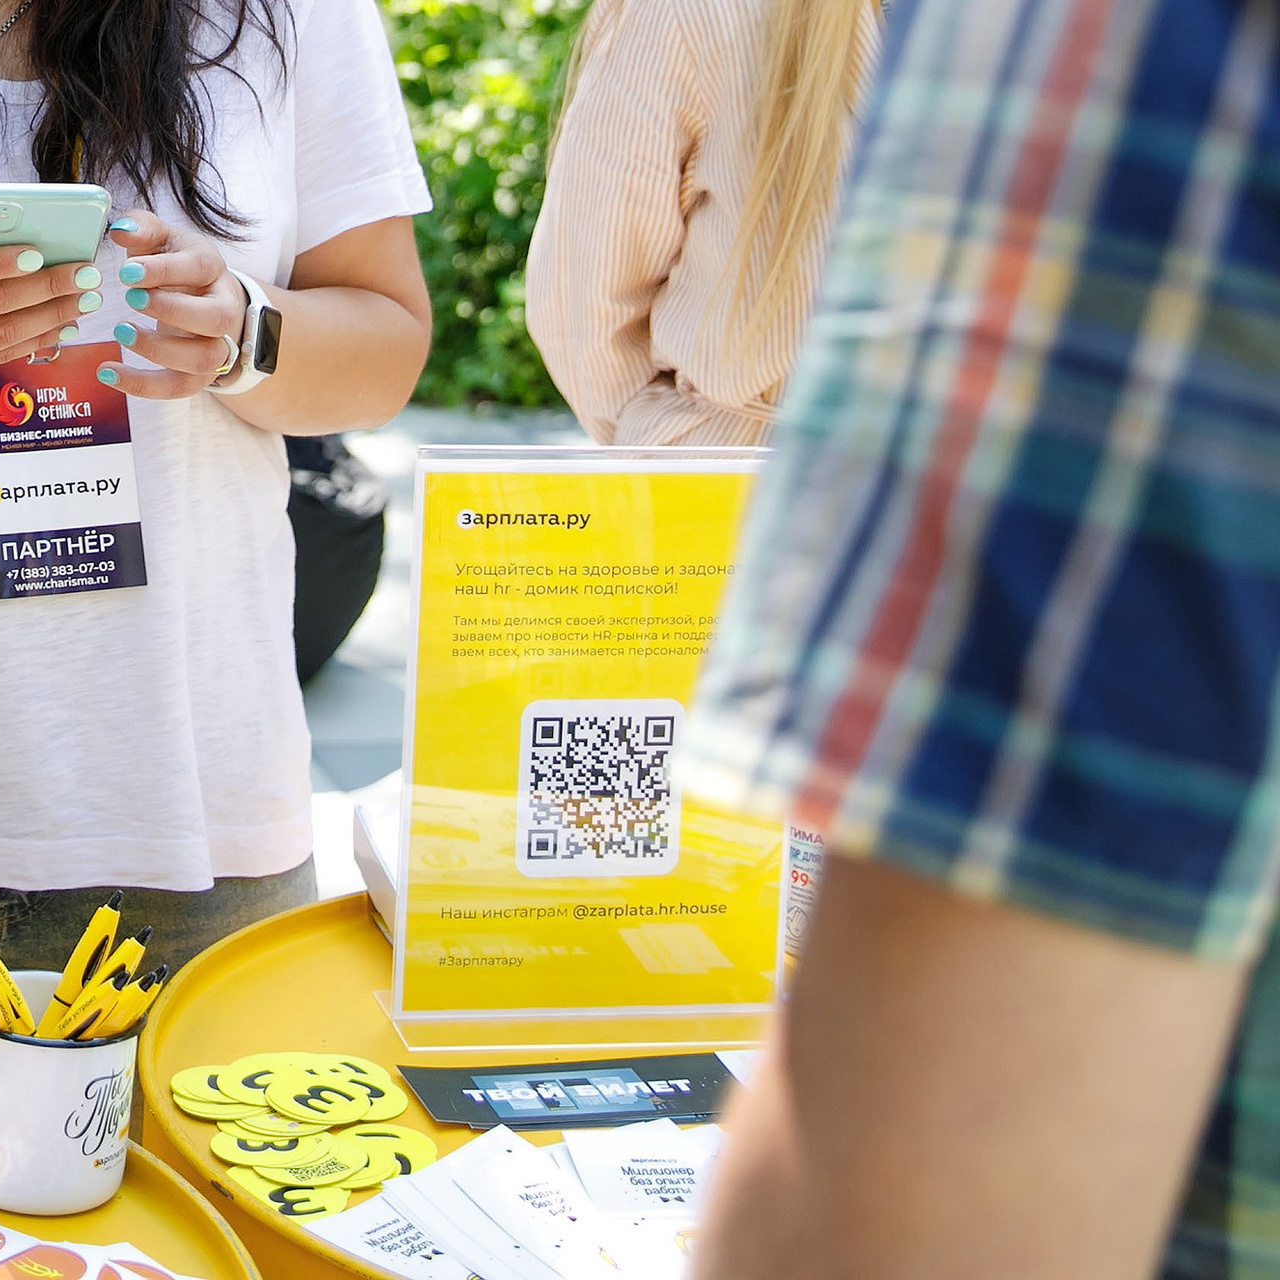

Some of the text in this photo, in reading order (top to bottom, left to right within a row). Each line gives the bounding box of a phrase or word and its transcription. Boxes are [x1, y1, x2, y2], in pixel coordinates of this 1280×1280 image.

[36, 386, 67, 404] ИГРЫ
[38, 401, 92, 422] ФЕНИКСА
[0, 426, 93, 443] БИЗНЕС-ПИКНИК
[462, 512, 591, 529] зарплата.ру
[2, 530, 115, 561] ПАРТНЁР
[6, 561, 115, 580] +7 (383) 383-07-03
[455, 563, 554, 577] Угощайтесь
[558, 565, 577, 576] на
[582, 564, 660, 578] здоровье
[664, 564, 674, 576] и
[14, 575, 109, 593] www.charisma.ru
[455, 584, 488, 595] наш
[493, 582, 511, 595] hr
[524, 584, 579, 597] домик
[583, 581, 678, 596] подпиской!
[453, 615, 477, 626] Там
[481, 616, 501, 626] мы
[503, 616, 562, 627] делимся
[565, 614, 605, 626] своей
[608, 614, 696, 627] экспертизой,
[452, 631, 502, 642] зываем
[505, 631, 531, 644] про
[535, 630, 589, 641] новости
[592, 629, 658, 643] HR-рынка
[661, 631, 670, 641] и
[451, 646, 484, 657] ваем
[488, 646, 520, 658] всех,
[523, 646, 545, 657] кто
[548, 644, 625, 657] занимается
[440, 901, 728, 921] Наш инстаграм @zarplata.hr.house
[438, 955, 524, 969] #Зарплатару
[462, 1078, 692, 1104] ТВОЙ БИЛЕТ
[620, 1166, 695, 1176] Миллионер
[630, 1175, 696, 1186] без опыта
[644, 1185, 692, 1195] работы
